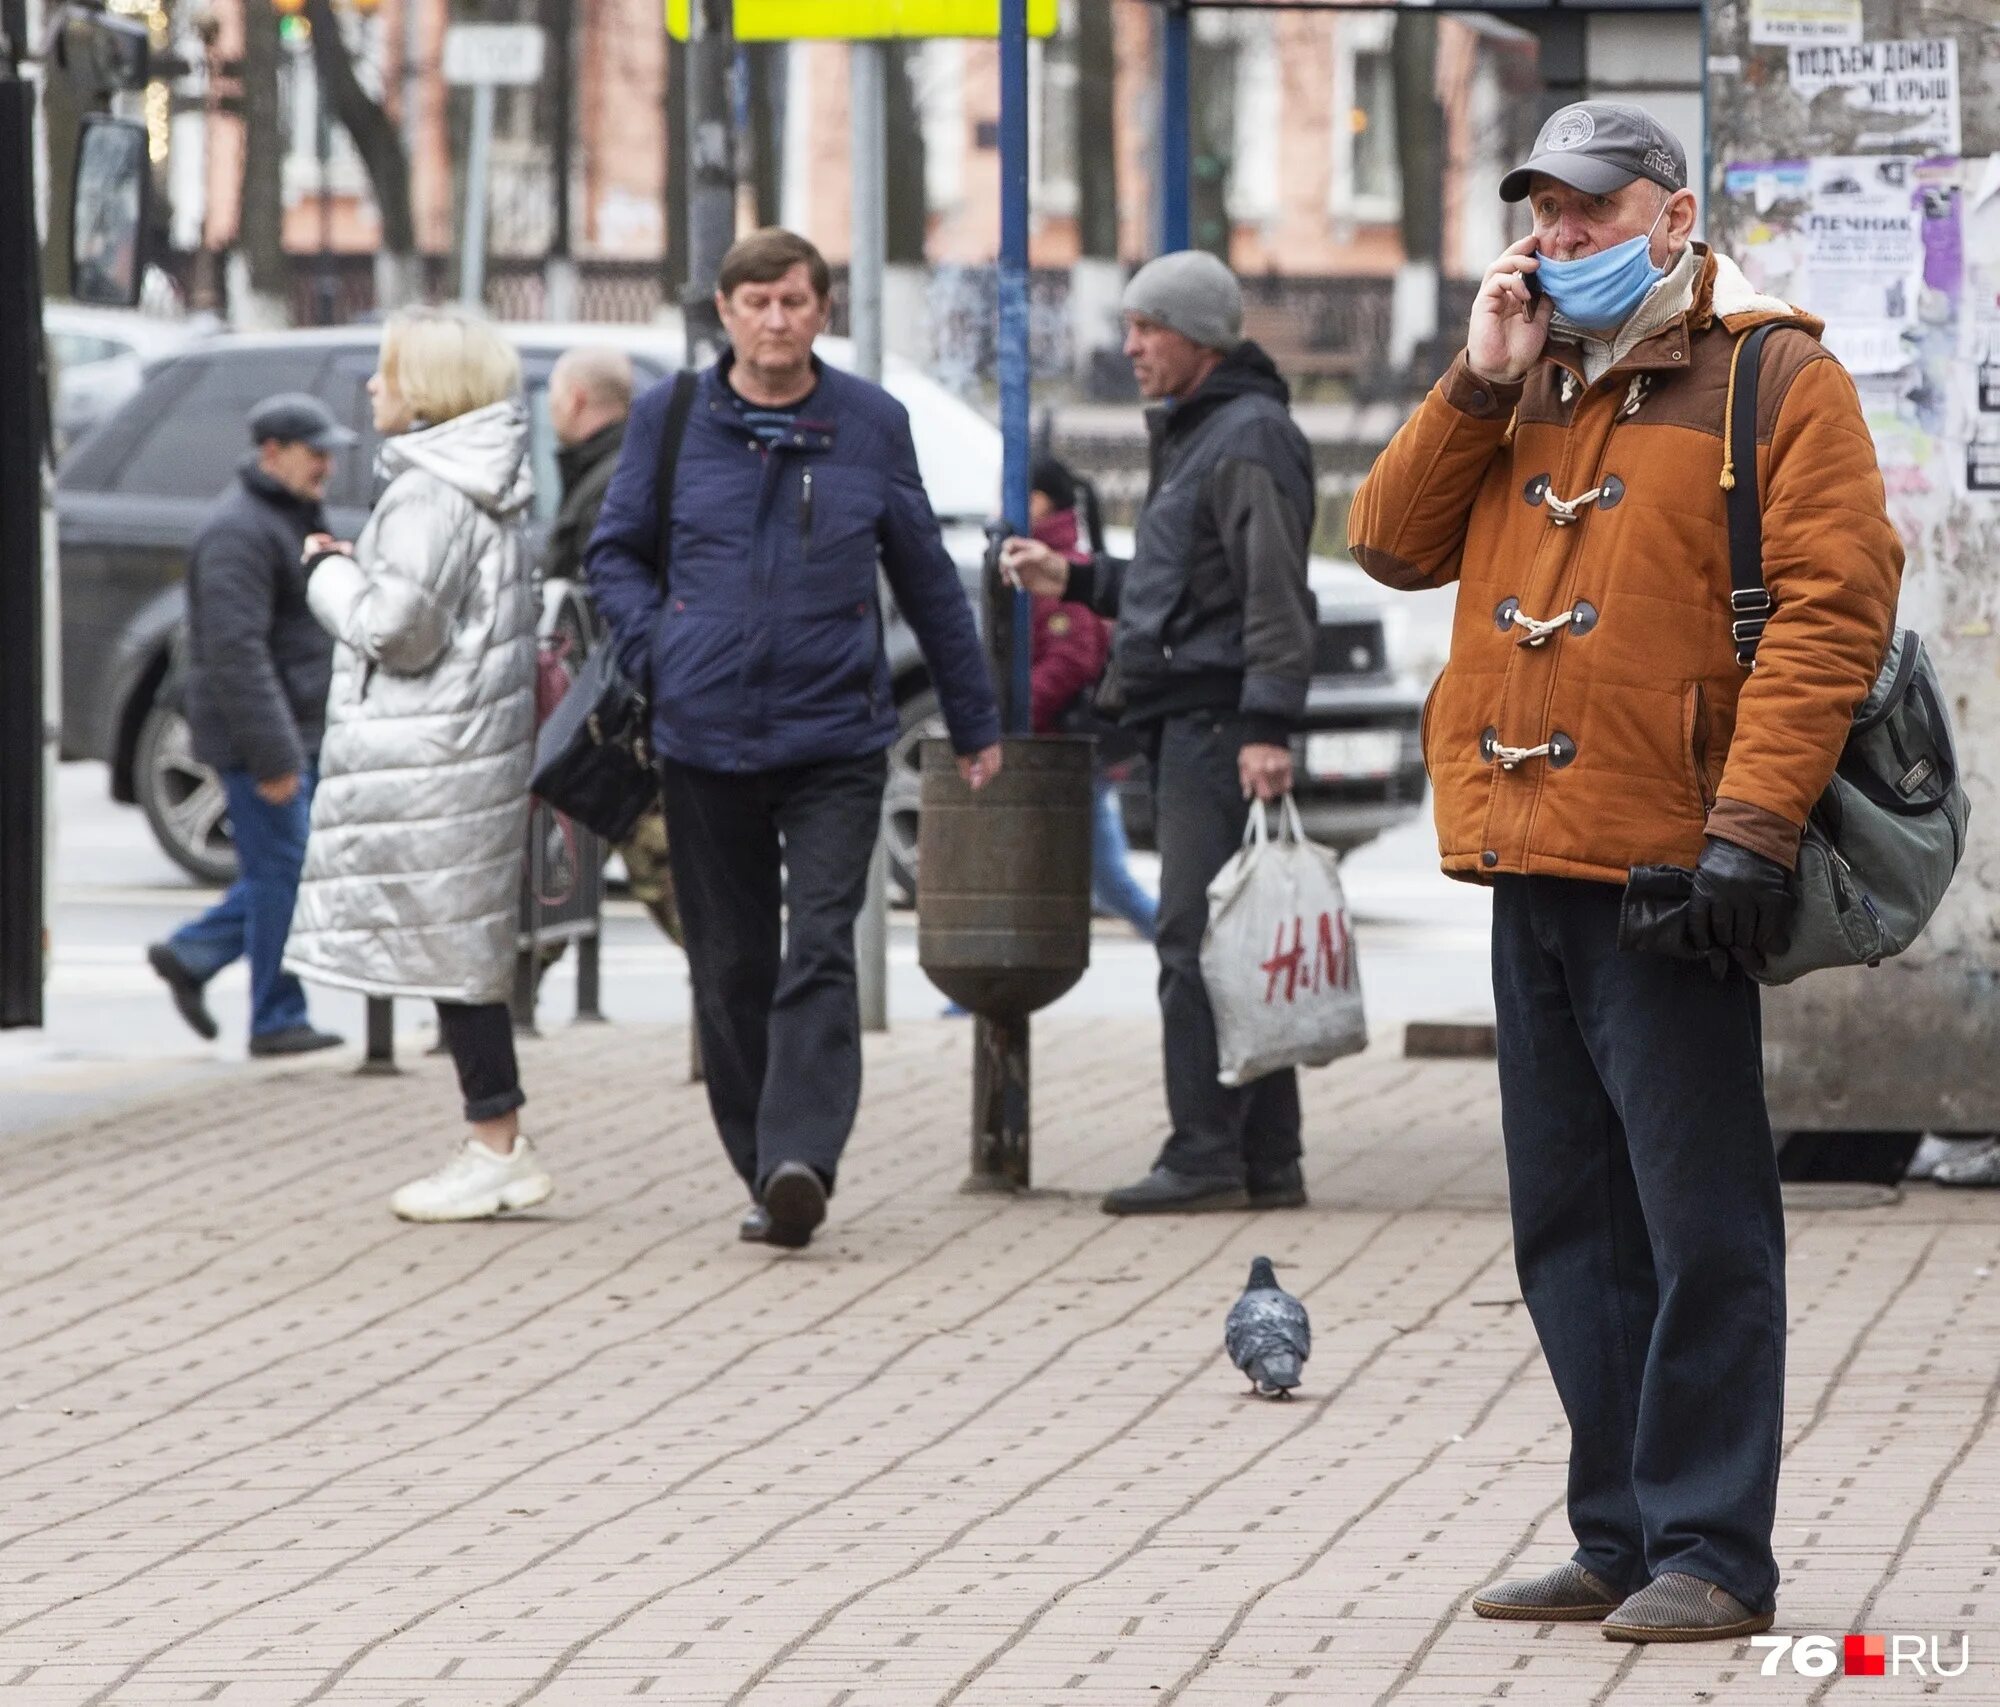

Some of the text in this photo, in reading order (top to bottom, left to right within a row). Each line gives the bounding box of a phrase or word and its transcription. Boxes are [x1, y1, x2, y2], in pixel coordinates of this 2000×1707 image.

[1797, 40, 1948, 76] ПОДЪЕМ ДОМОВ
[1897, 78, 1950, 101] КРЫШ
[1810, 215, 1912, 231] ПЕЧНИК
